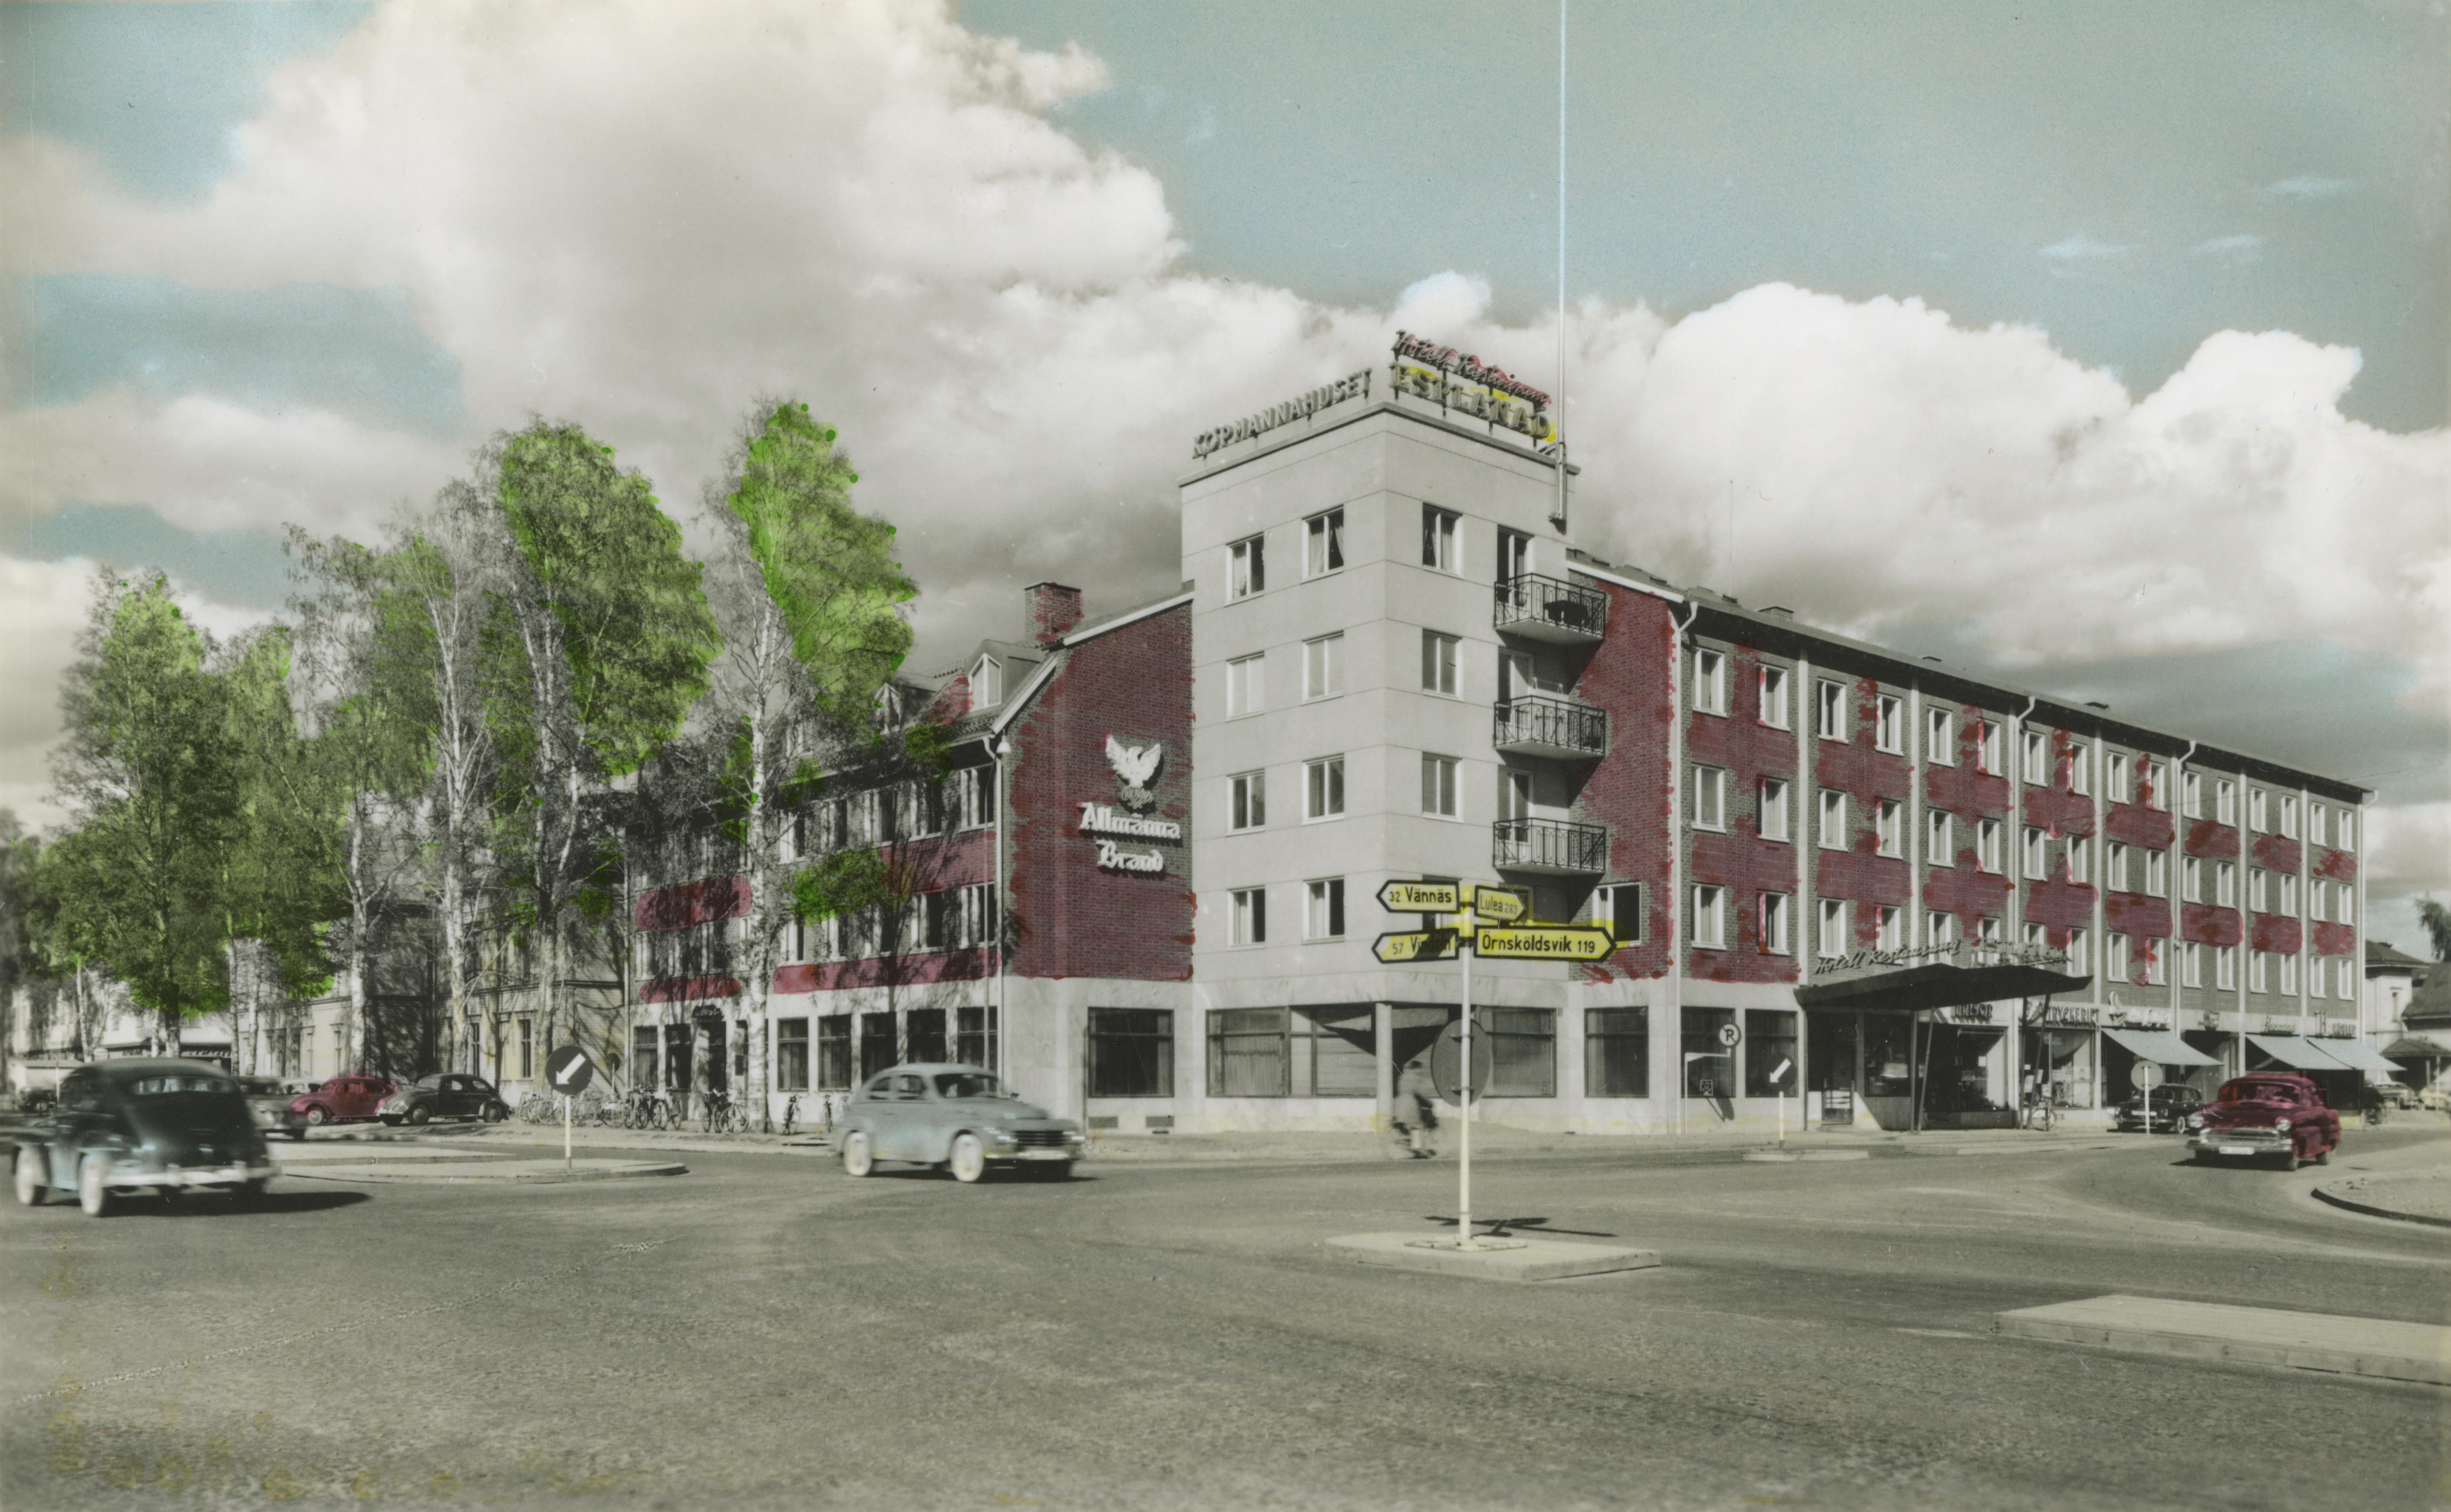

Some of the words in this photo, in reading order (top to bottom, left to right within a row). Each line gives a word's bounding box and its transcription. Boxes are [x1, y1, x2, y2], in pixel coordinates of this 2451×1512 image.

[1391, 329, 1459, 371] Hotell
[1192, 367, 1372, 459] KÖPMANNAHUSET
[1389, 361, 1550, 439] ESPLANAD
[1076, 802, 1181, 839] Allmänna
[1096, 839, 1164, 872] Brand
[1389, 891, 1400, 902] 32
[1405, 886, 1452, 903] Vännäs
[1392, 943, 1403, 955] 57
[1482, 930, 1572, 953] Örnsköldsvik
[1578, 940, 1595, 953] 119
[1815, 952, 1866, 974] Hotell
[1868, 939, 1961, 965] Restaurang
